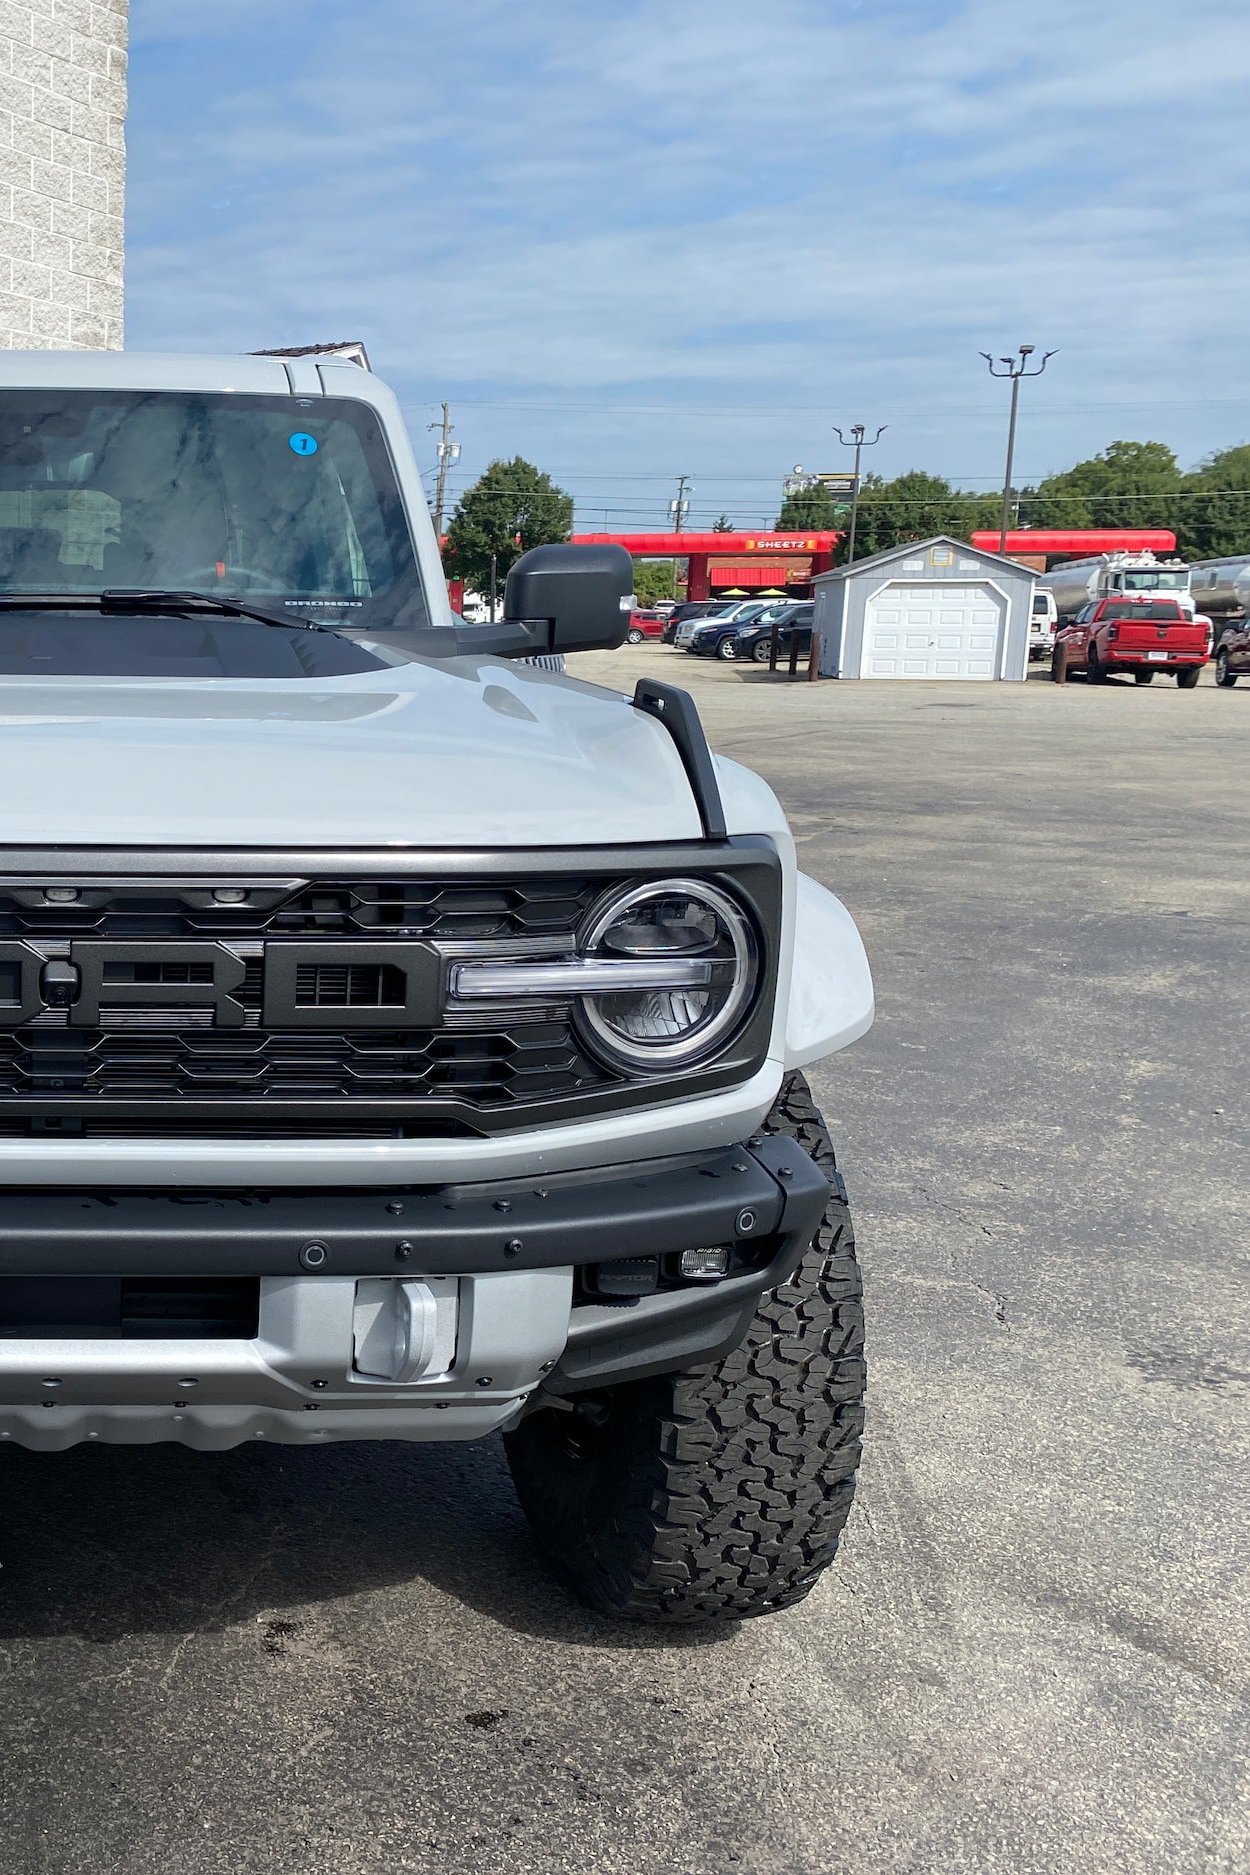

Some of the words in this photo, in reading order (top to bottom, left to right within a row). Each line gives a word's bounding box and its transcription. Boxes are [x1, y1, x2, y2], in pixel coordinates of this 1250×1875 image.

[300, 438, 308, 451] 1
[757, 541, 805, 549] SHEETZ
[599, 1273, 654, 1282] RAPTOR
